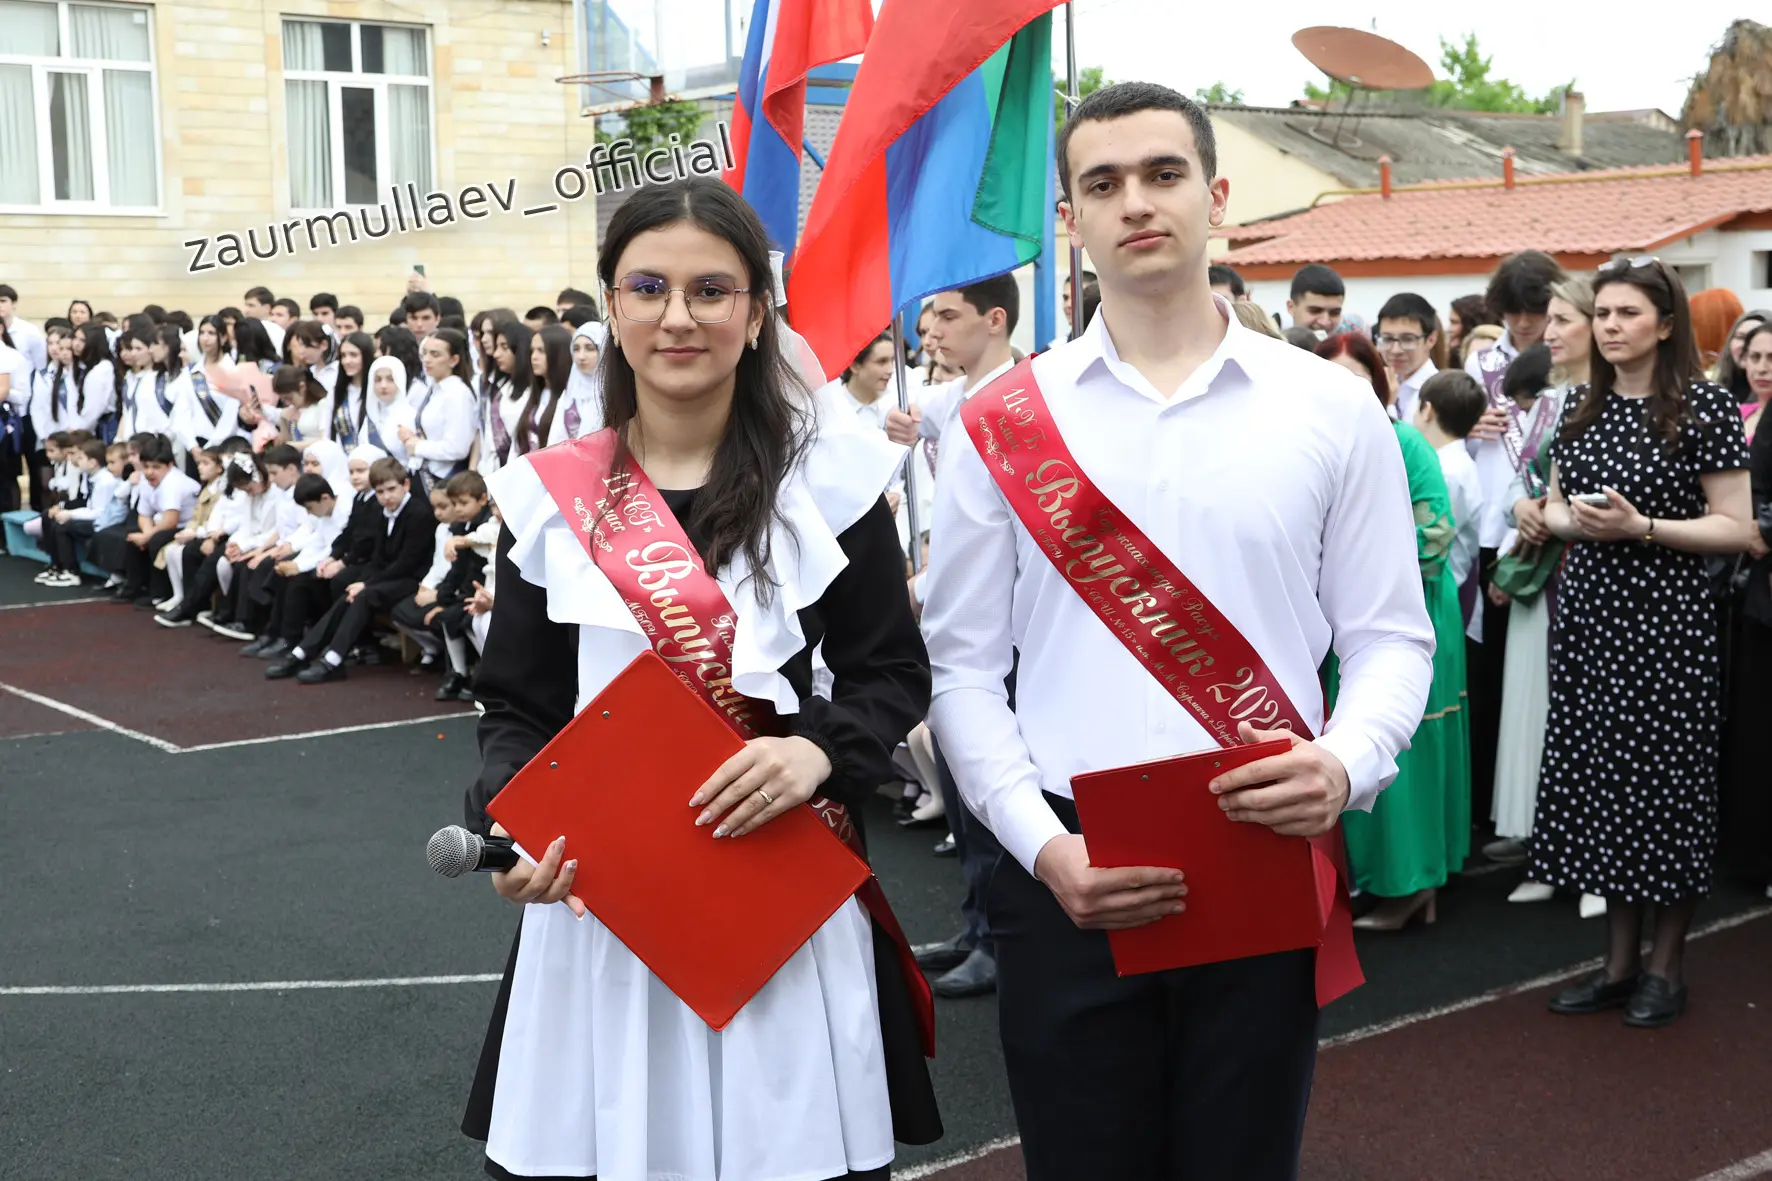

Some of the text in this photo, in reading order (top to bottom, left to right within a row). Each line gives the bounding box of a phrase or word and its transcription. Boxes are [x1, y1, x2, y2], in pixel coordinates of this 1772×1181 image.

[1002, 388, 1029, 411] 11
[997, 416, 1020, 452] класс
[602, 472, 638, 497] 11
[595, 498, 626, 533] класс
[1026, 459, 1216, 677] Выпускник
[624, 598, 658, 636] МБОУ
[1181, 597, 1222, 641] Расул
